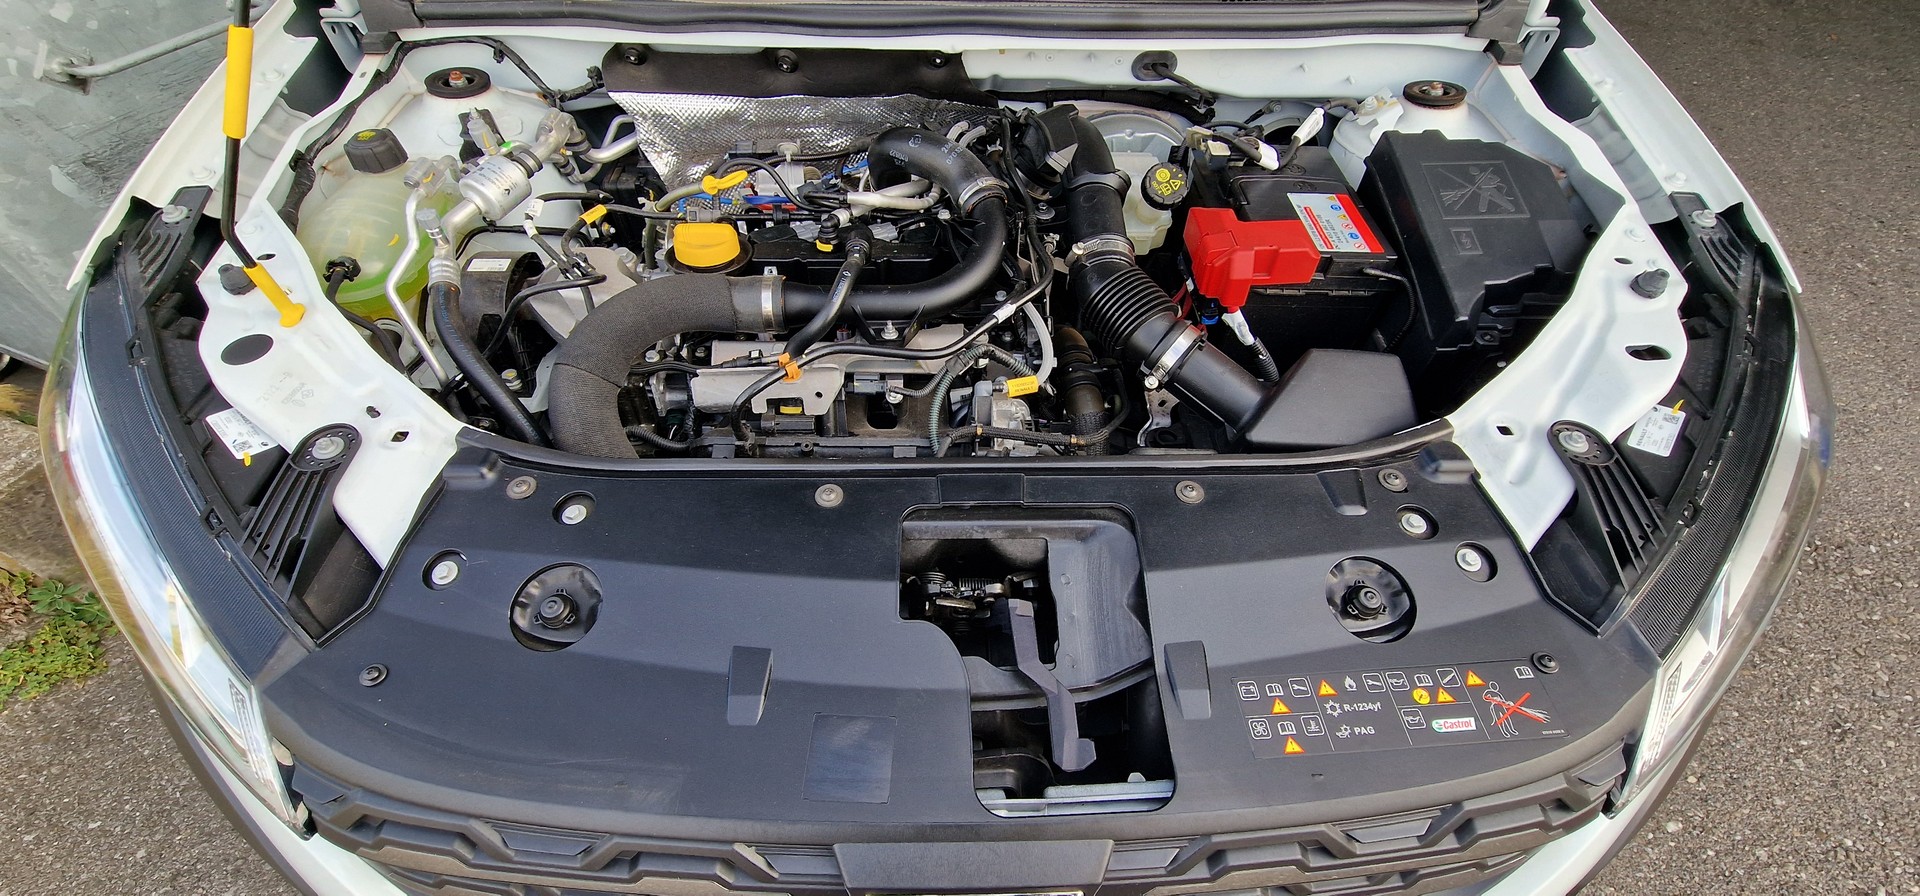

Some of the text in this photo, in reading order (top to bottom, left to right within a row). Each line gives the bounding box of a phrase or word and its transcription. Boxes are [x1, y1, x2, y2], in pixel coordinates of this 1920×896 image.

[1343, 702, 1381, 713] R-1234yf
[1443, 718, 1473, 731] Castrol
[1354, 725, 1376, 736] PAG
